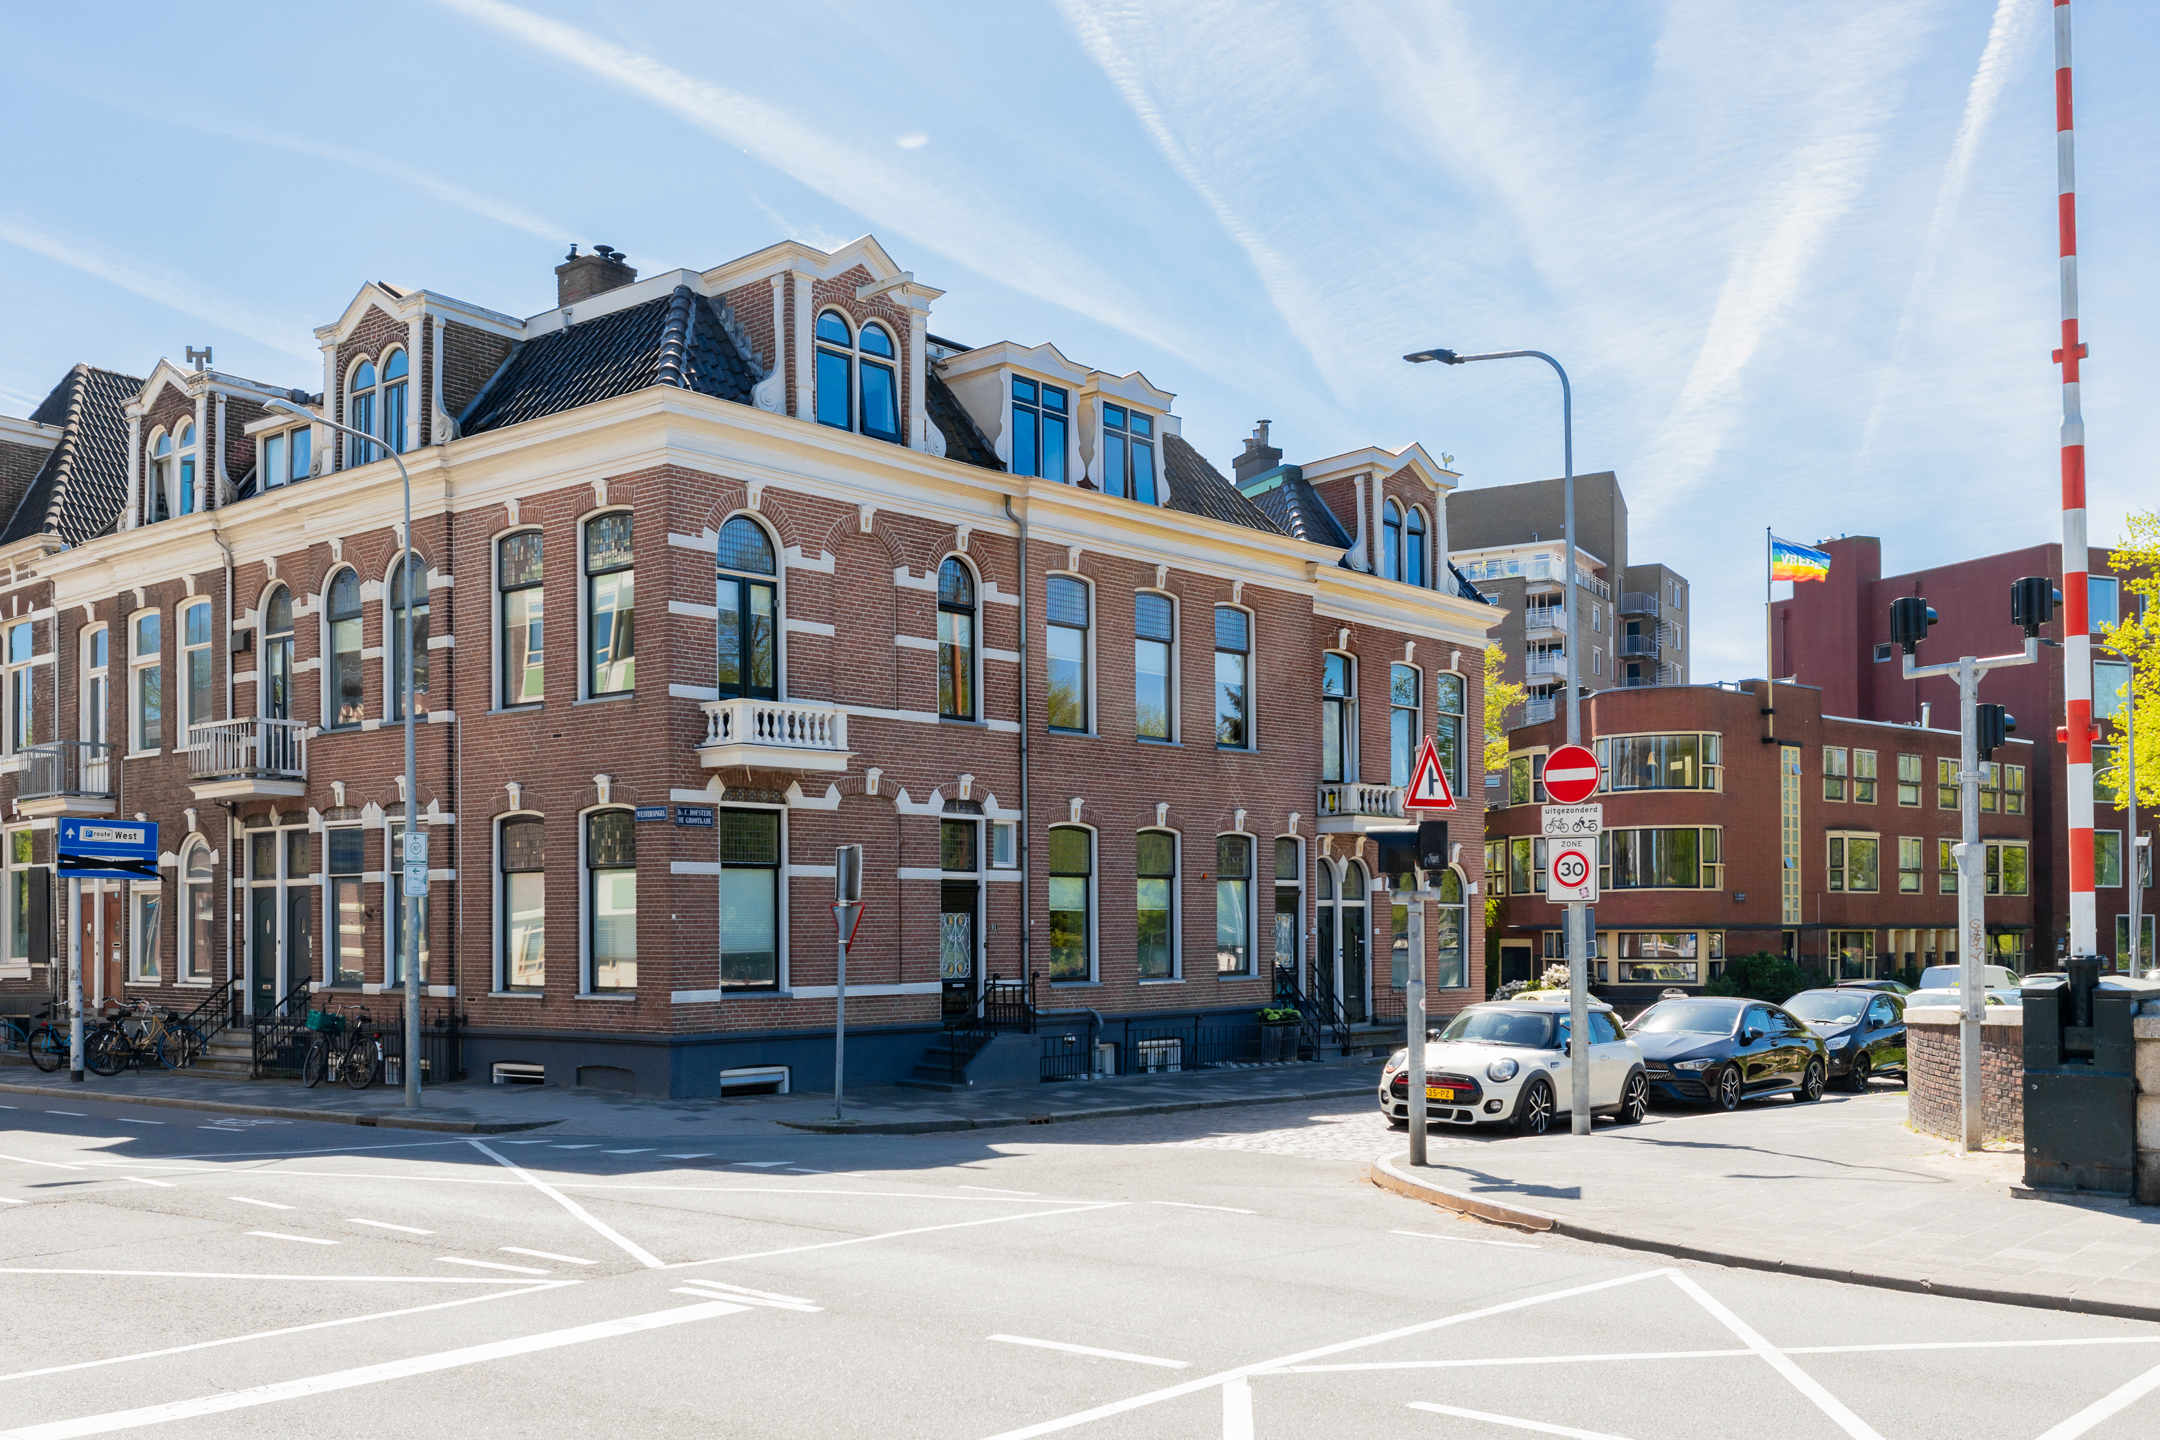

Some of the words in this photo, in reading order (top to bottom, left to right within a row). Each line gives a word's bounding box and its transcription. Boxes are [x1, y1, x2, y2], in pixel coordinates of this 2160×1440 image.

[636, 810, 666, 818] WESTERSINGEL
[690, 809, 712, 817] HOFSTEDE
[1545, 807, 1598, 815] uitgezonderd
[115, 831, 137, 840] West
[1560, 862, 1584, 877] 30
